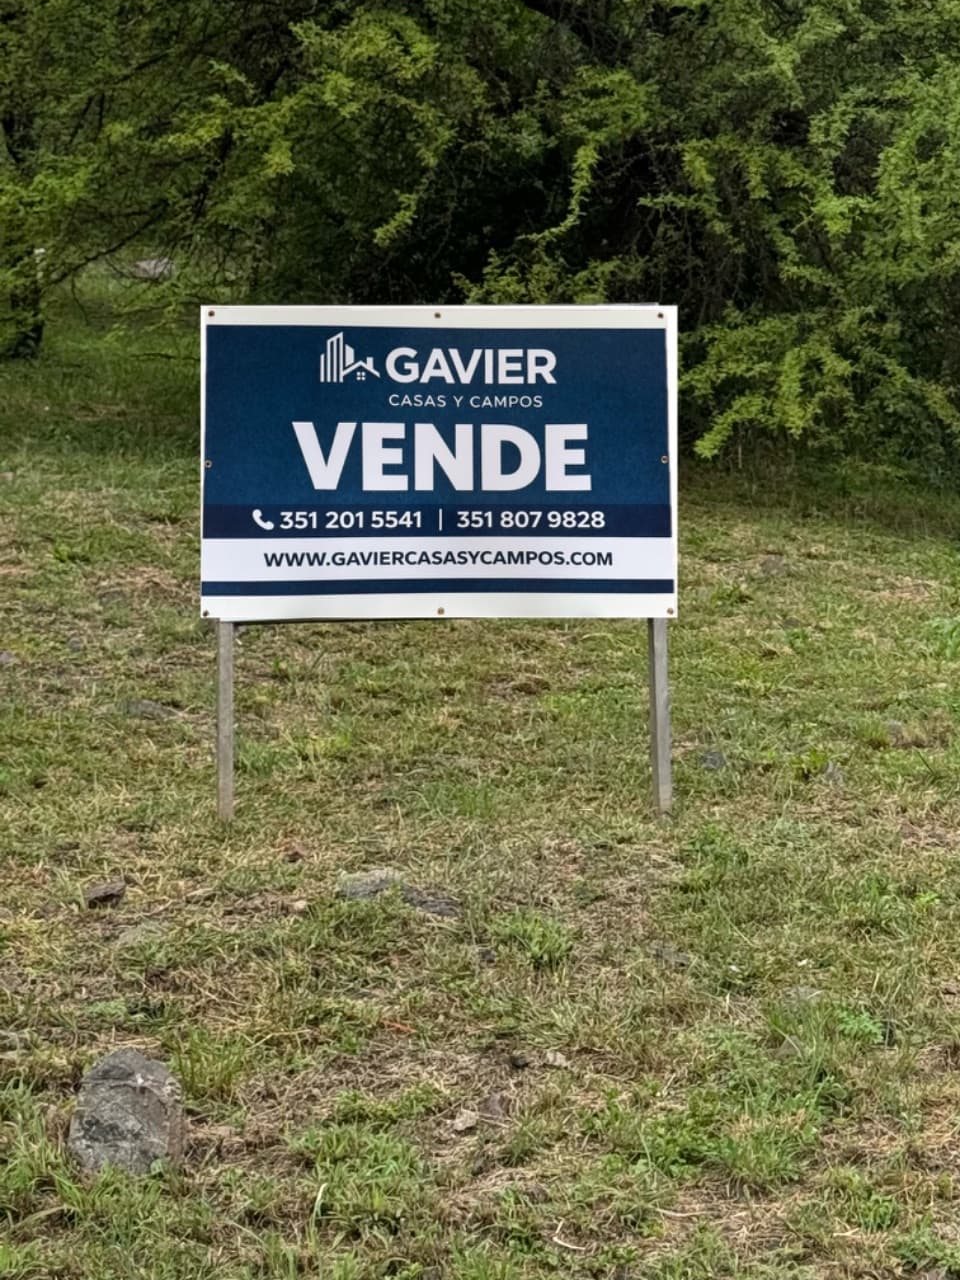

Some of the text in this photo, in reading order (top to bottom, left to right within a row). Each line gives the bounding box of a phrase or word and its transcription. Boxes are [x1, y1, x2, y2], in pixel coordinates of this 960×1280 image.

[385, 347, 557, 385] GAVIER
[388, 393, 543, 408] CASAS Y CAMPOS
[291, 421, 592, 492] VENDE
[279, 511, 606, 529] 351 201 5541 351 807 9828
[264, 550, 613, 568] WWW.GAVIERCASASYCAMPOS.COM
